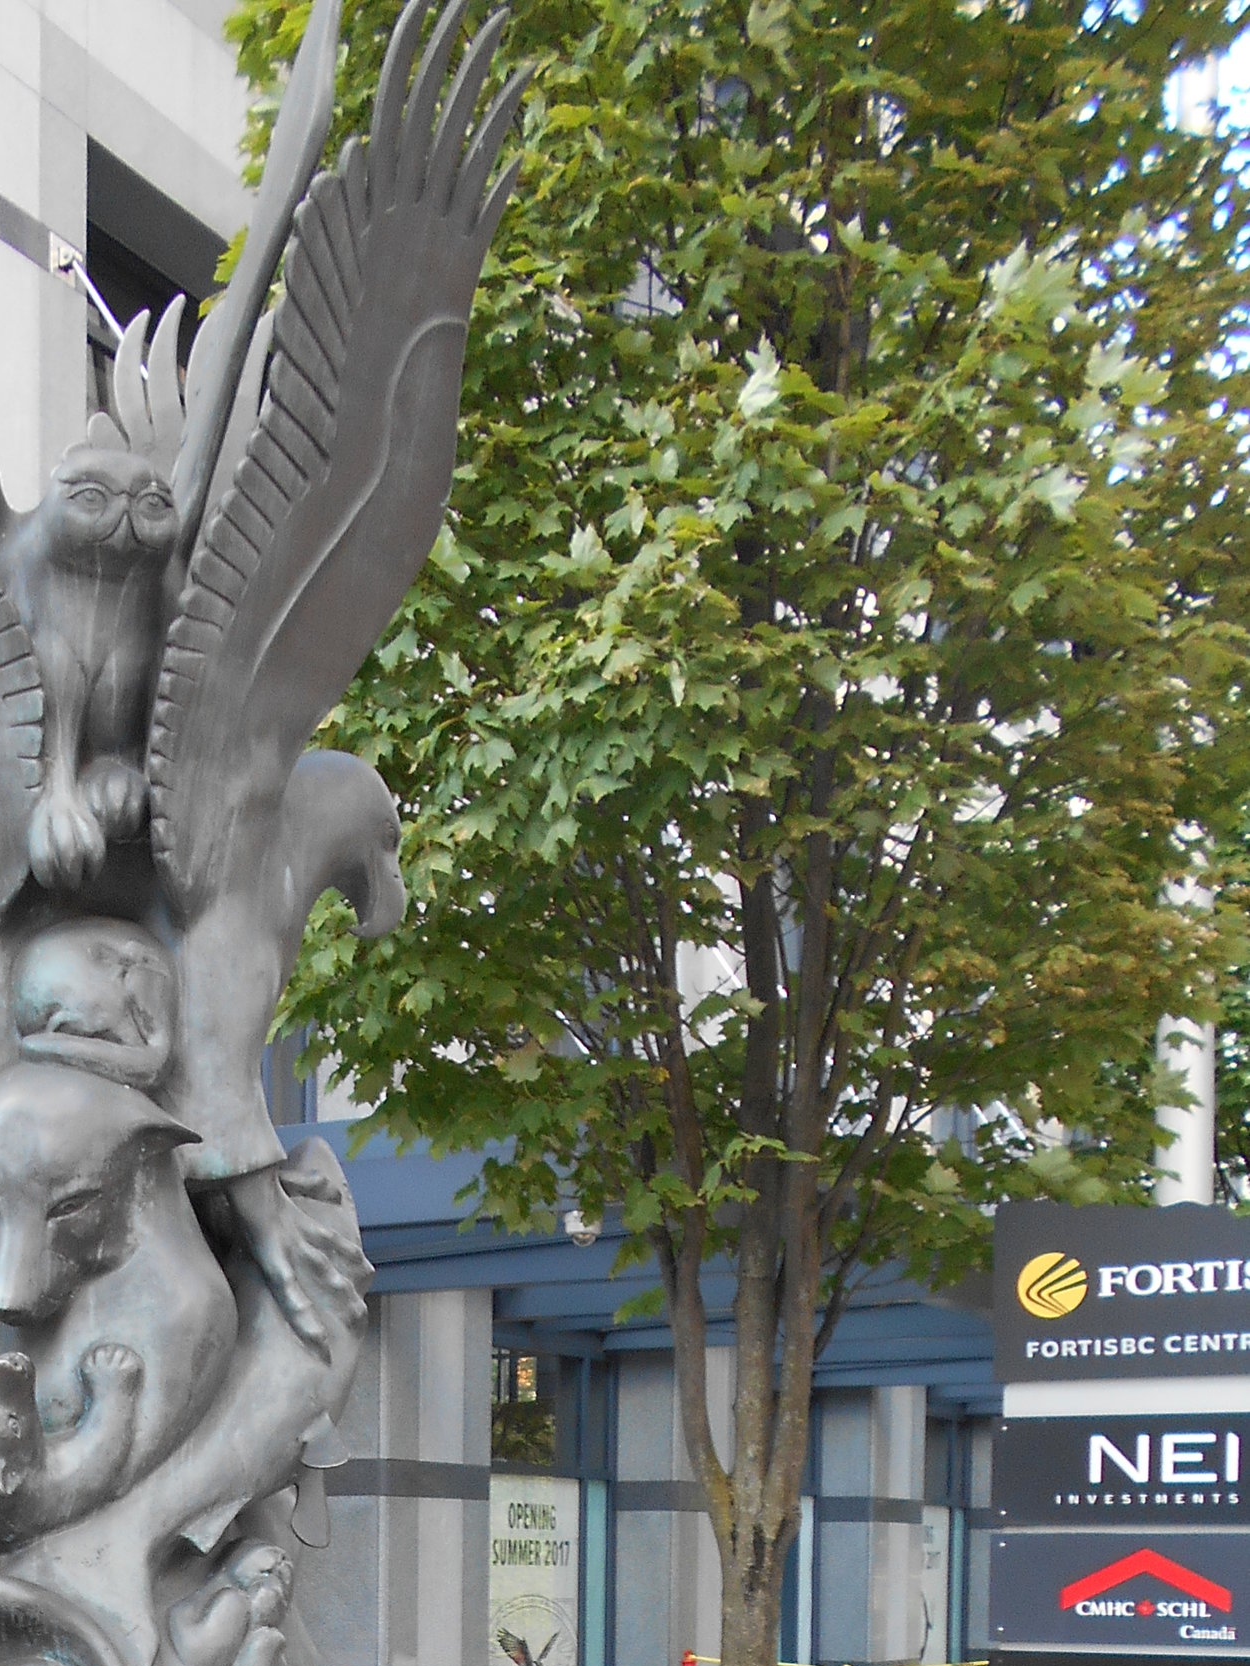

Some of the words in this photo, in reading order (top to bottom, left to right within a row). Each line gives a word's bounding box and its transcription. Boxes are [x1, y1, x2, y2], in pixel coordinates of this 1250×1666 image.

[1026, 1336, 1155, 1358] FORTISBC
[1089, 1432, 1239, 1483] NEI
[1055, 1493, 1240, 1505] INVESTMENTS
[508, 1502, 557, 1530] OPENING
[492, 1539, 542, 1566] SUMMER
[544, 1540, 570, 1567] 2017
[1075, 1602, 1135, 1616] CMHC
[1156, 1603, 1211, 1618] SCHL
[1179, 1625, 1236, 1640] Canada
